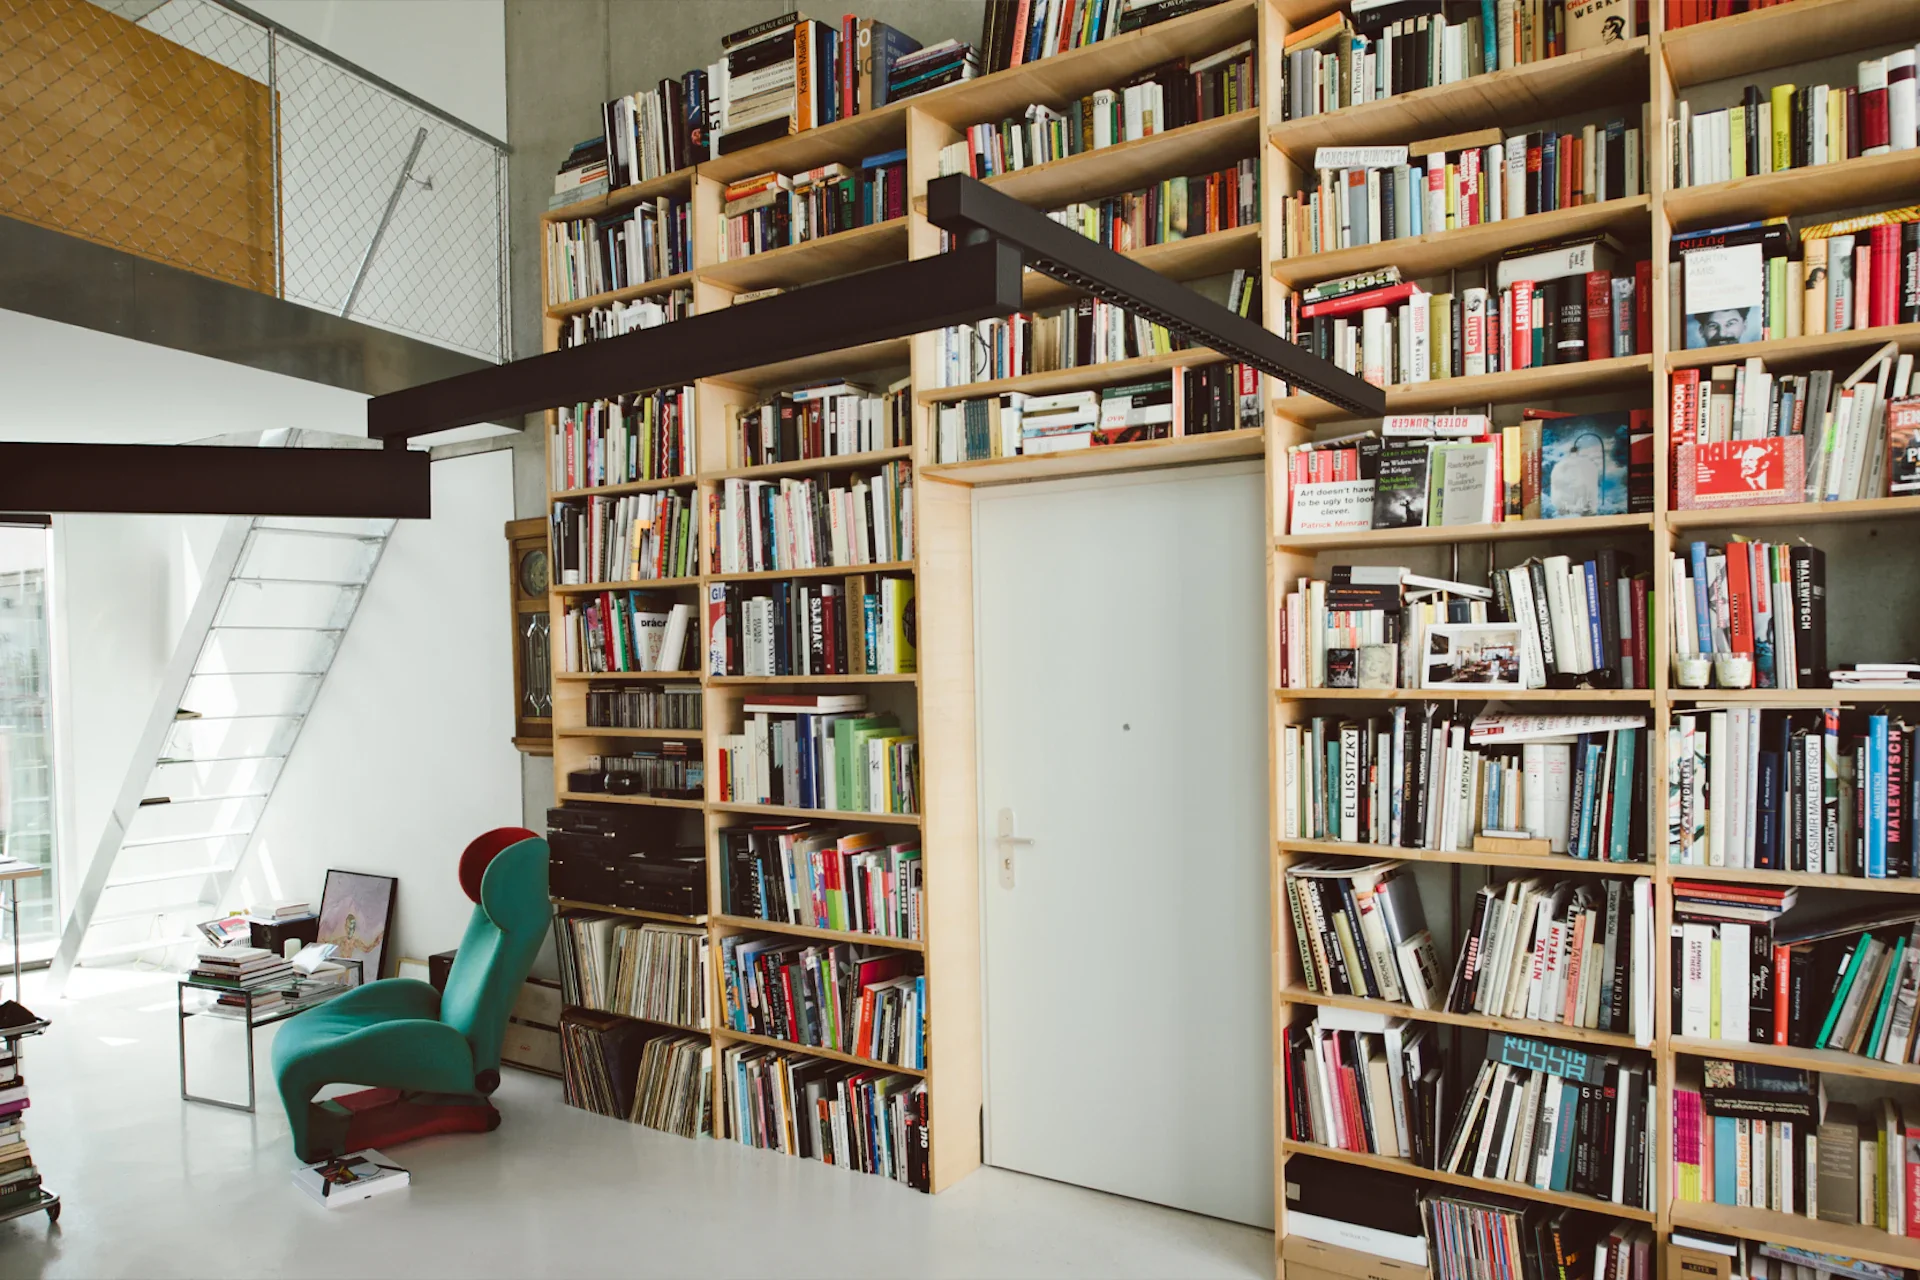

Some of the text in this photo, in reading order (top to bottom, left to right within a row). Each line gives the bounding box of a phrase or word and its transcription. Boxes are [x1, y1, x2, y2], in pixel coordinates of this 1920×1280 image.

[798, 29, 809, 96] Karel Malich
[1353, 51, 1363, 96] Petrohrad
[1318, 148, 1406, 168] VLADIMIR NABOKOV
[1468, 153, 1478, 195] Schiwago
[1679, 235, 1725, 249] PUTIN
[1689, 253, 1728, 266] MARTIN
[1689, 266, 1716, 278] AMIS
[1516, 289, 1528, 331] LENIN
[1835, 298, 1844, 329] TROTZKI
[1464, 316, 1482, 355] Lenin
[1391, 417, 1468, 428] ROTER HUNGER
[1673, 383, 1685, 433] МОСКВА
[1685, 384, 1696, 433] BERLIN
[1390, 458, 1425, 467] Widerschein
[1390, 466, 1411, 475] Krieges
[1297, 495, 1375, 509] to be ugly to look
[1300, 485, 1375, 497] Art doesn't have
[1320, 508, 1350, 516] clever.
[1301, 519, 1369, 529] Patrick Mimran
[1800, 559, 1812, 630] MALEWITSCH
[767, 602, 775, 675] FLUXUS CODEX
[851, 581, 861, 663] NEGATIVE SPACE
[867, 611, 875, 666] Kontext Kunst
[1541, 623, 1552, 651] GROSSE
[1345, 732, 1356, 819] EL LISSITZKY
[1460, 754, 1470, 800] KANDINSKY
[1682, 760, 1692, 813] KANDINSKY
[1887, 730, 1900, 842] MALEWITSCH
[1571, 769, 1583, 839] WASSILY KANDINSKY
[1808, 742, 1818, 864] KASIMIR MALEWITSCH
[1828, 808, 1837, 852] MALEVICH
[1289, 880, 1303, 929] МАЛЕВИЧ
[1308, 880, 1328, 933] МЕЛЬНИКОВ
[1547, 927, 1560, 972] TATLIN
[1564, 909, 1577, 957] TATLIN
[1299, 939, 1315, 989] MALEVICH
[1376, 951, 1390, 988] RODCHENKO
[1533, 938, 1546, 980] TATLIN
[1570, 947, 1580, 976] TATLIN
[1613, 965, 1624, 1016] MICHAIL
[1582, 1086, 1590, 1097] 5
[1714, 1101, 1732, 1109] Jahre
[1733, 1102, 1762, 1113] Zwanziger
[1774, 1105, 1810, 1116] Tendenzen
[919, 1126, 928, 1149] out
[1737, 1135, 1748, 1188] Bis Heute
